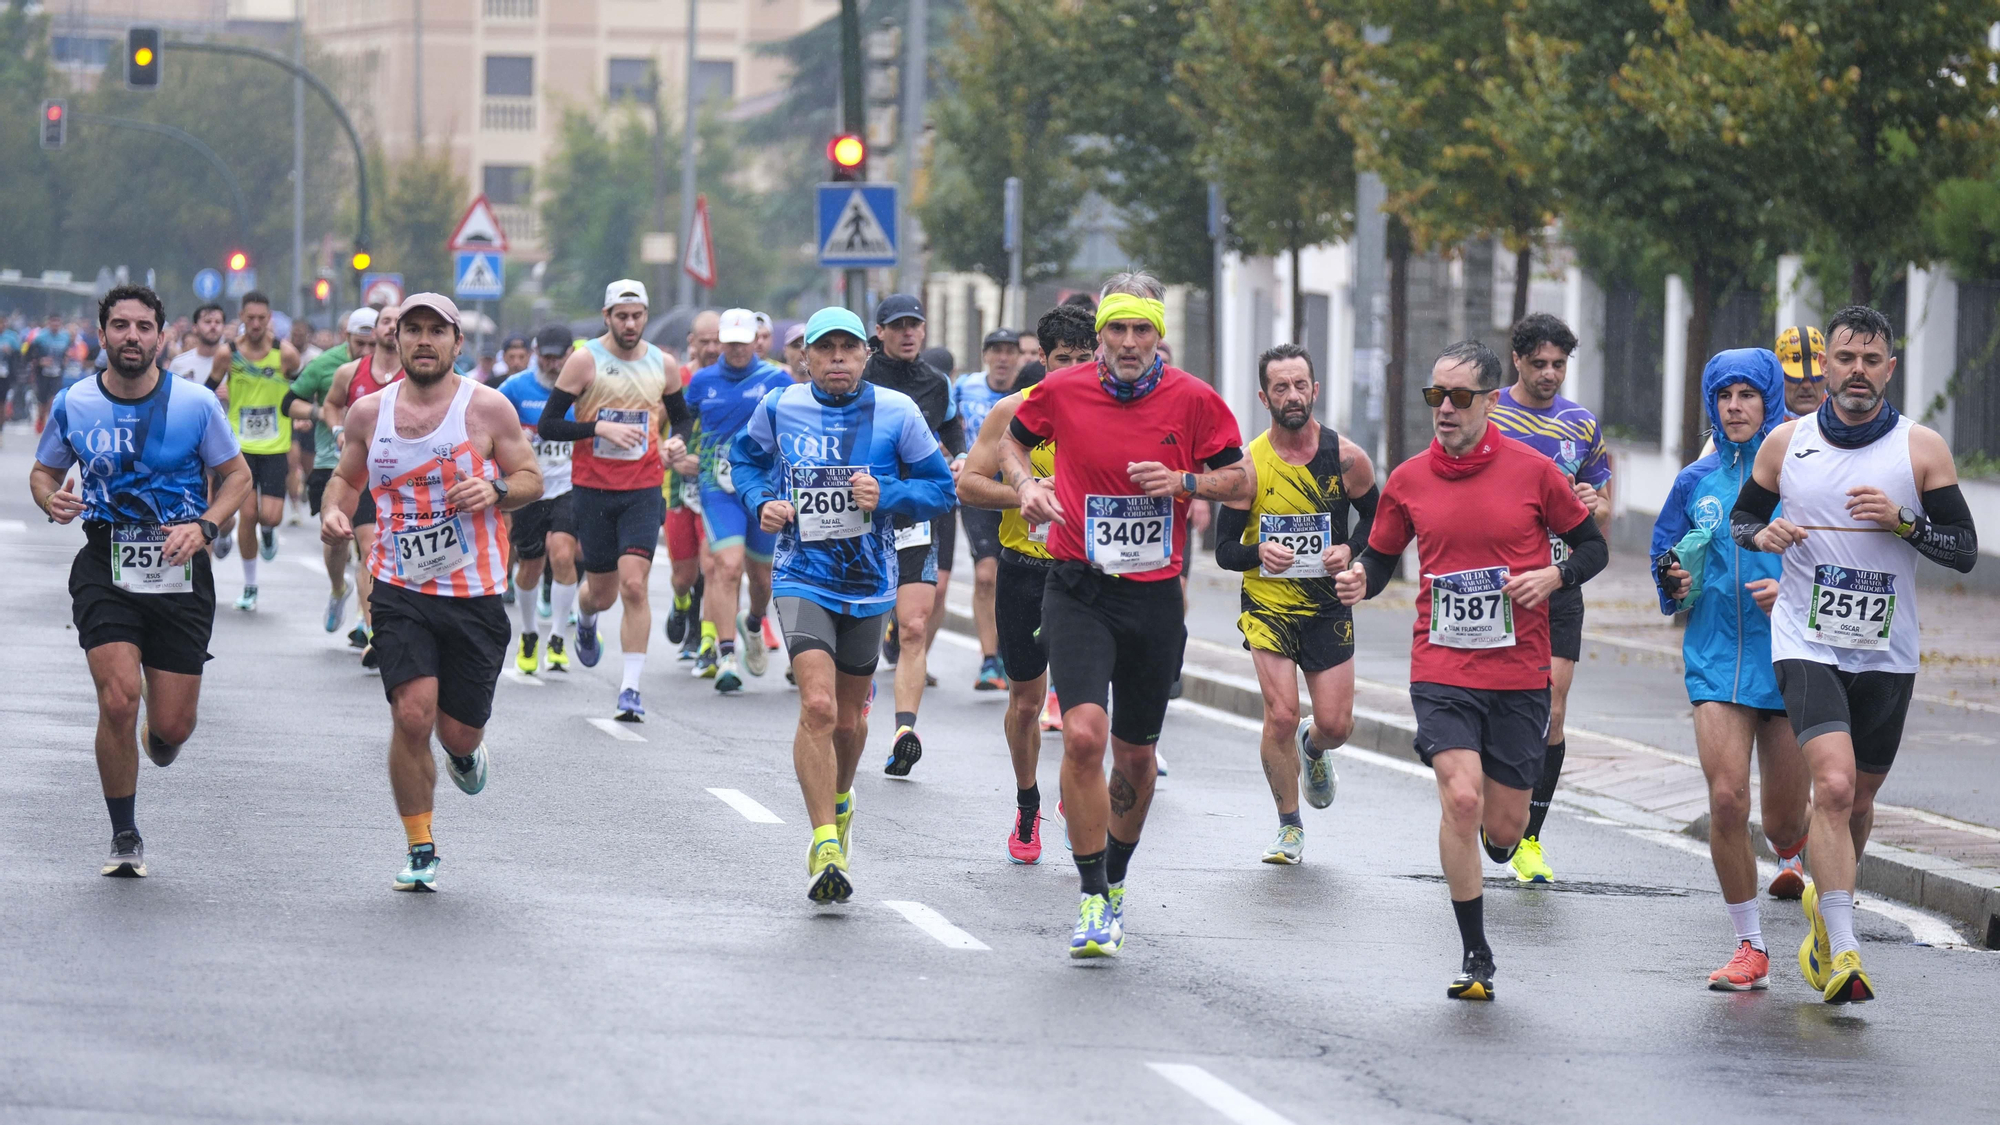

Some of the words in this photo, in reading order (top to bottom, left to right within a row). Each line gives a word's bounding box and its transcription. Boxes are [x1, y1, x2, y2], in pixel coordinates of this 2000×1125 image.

[800, 491, 860, 515] 2605
[1126, 497, 1155, 505] MEDIA
[1096, 504, 1113, 516] 59
[121, 532, 137, 541] 59
[1096, 521, 1162, 546] 3402
[400, 525, 457, 560] 3172
[417, 555, 446, 569] ALEJANDRO
[1018, 555, 1054, 568] NIKE
[1460, 570, 1491, 581] MEDIA
[1823, 572, 1840, 586] 59
[1856, 570, 1883, 580] MEDIA
[1461, 578, 1492, 587] MARATÓN
[1441, 593, 1501, 621] 1587
[1818, 590, 1887, 622] 2512
[1840, 623, 1860, 632] ÓSCAR
